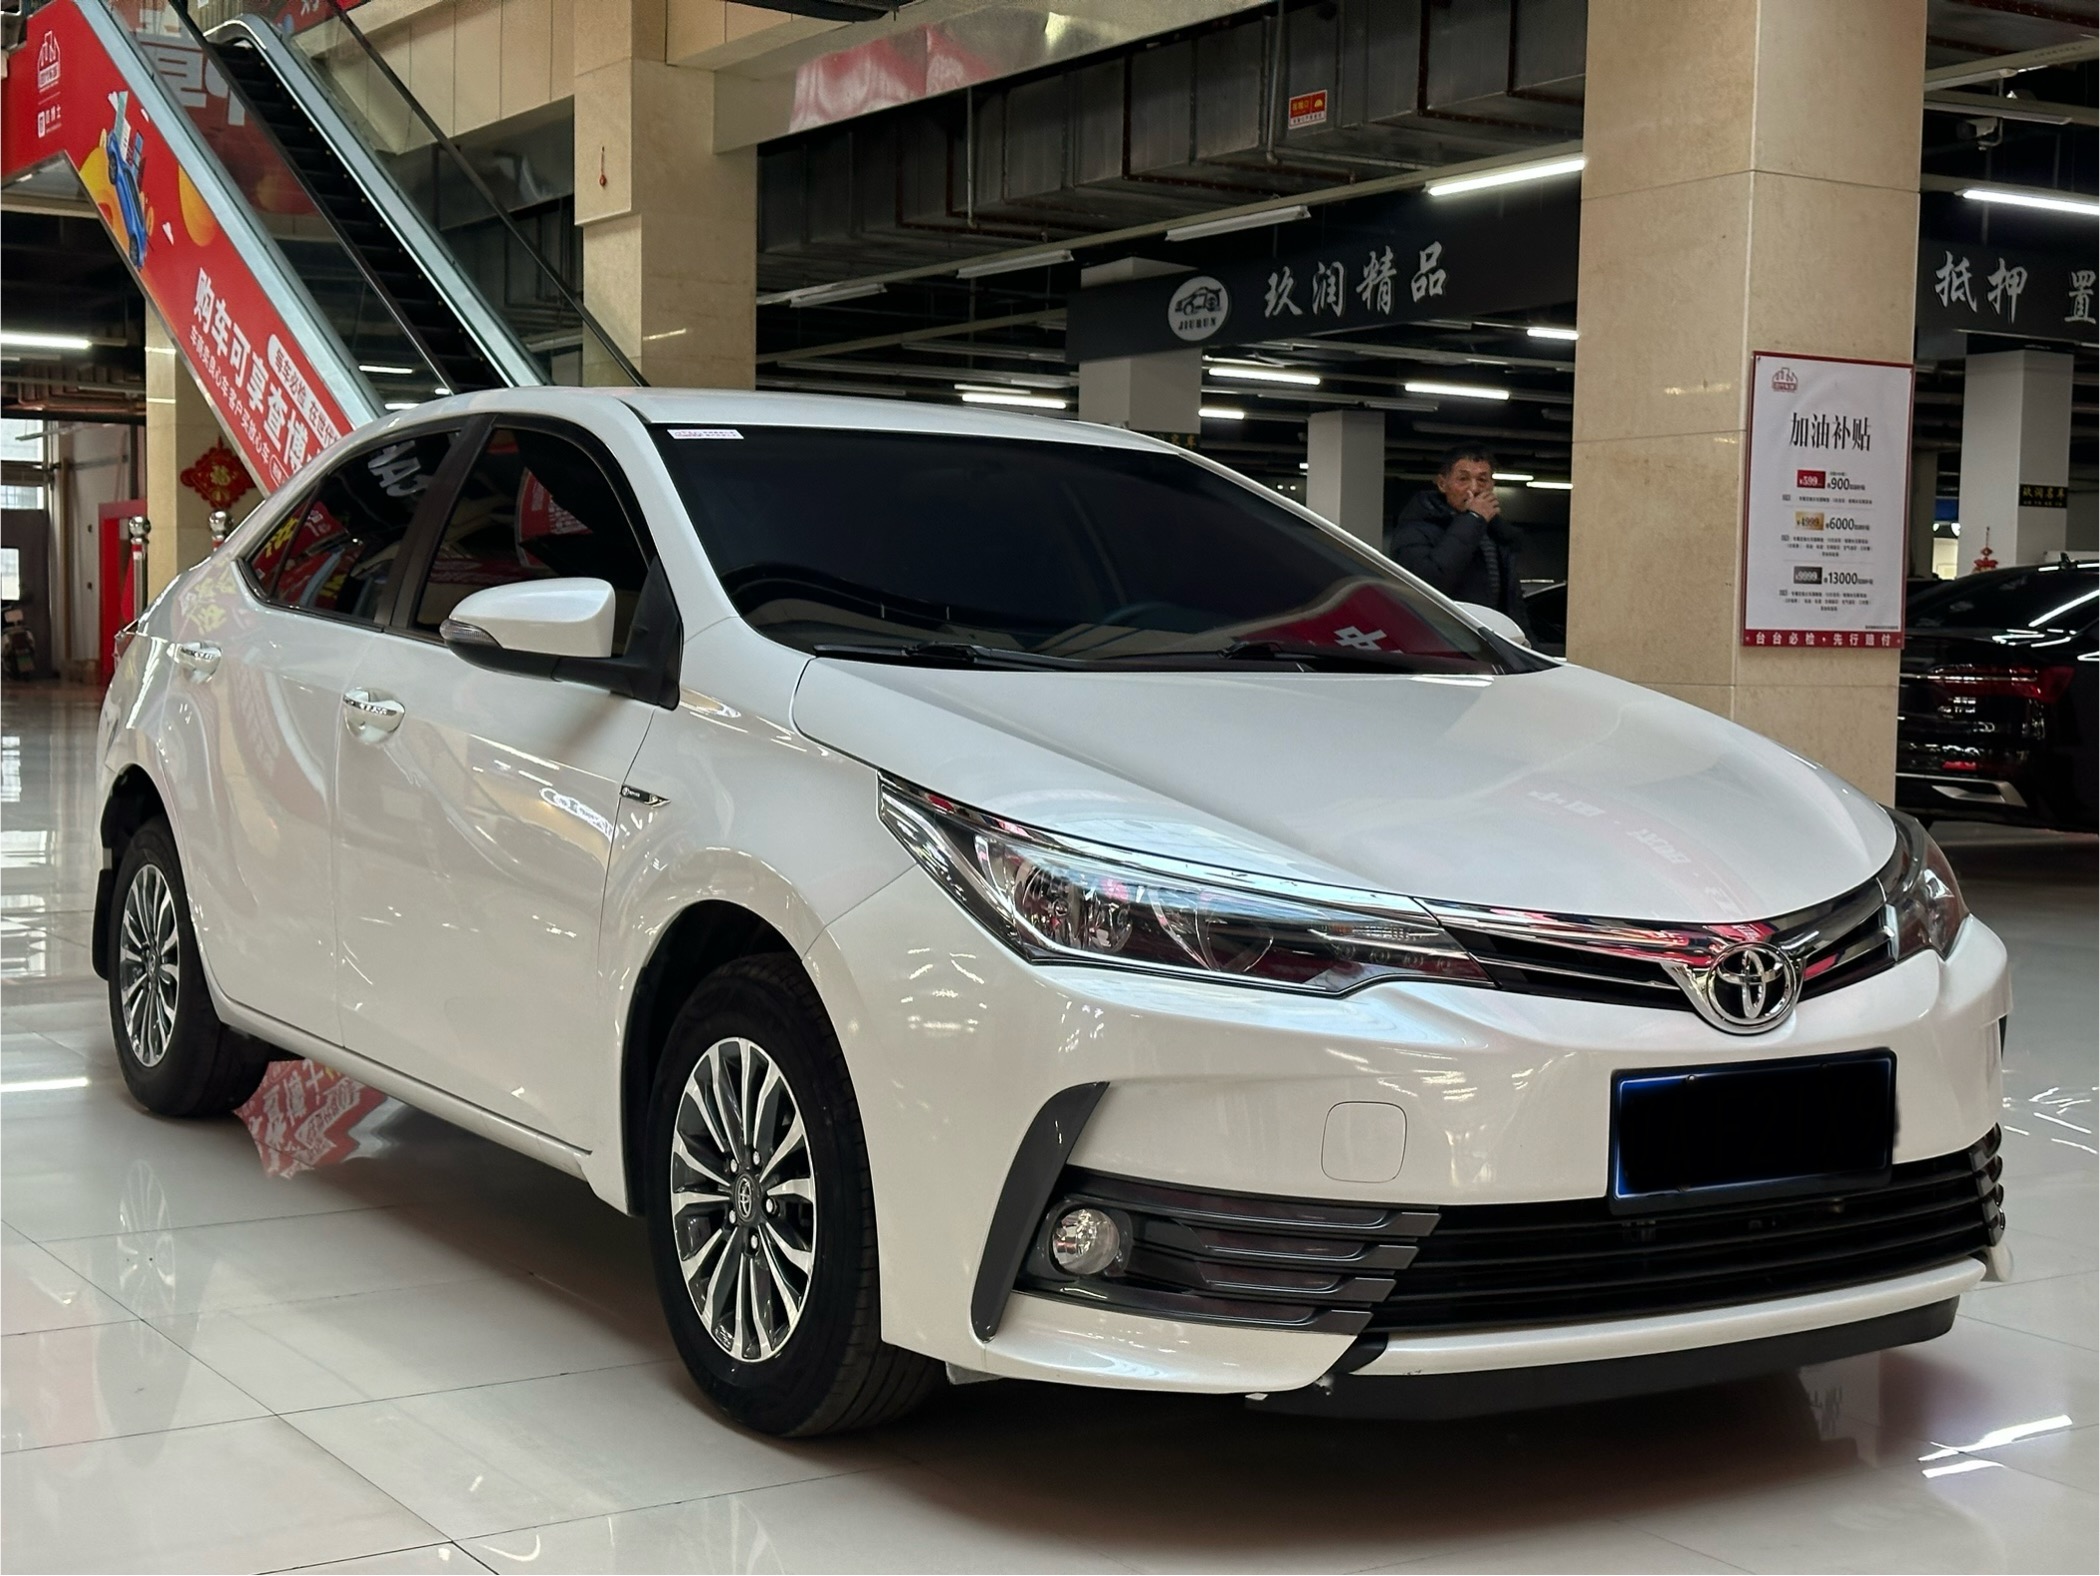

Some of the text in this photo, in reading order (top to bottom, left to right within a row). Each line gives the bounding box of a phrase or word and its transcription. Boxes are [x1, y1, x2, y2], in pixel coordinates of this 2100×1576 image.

[1264, 241, 1447, 318] 玖润精品
[1934, 250, 2097, 325] 抵押 置
[1178, 316, 1217, 331] JIURUN
[193, 267, 322, 475] 购车可享查博
[1788, 411, 1872, 452] 加油补贴
